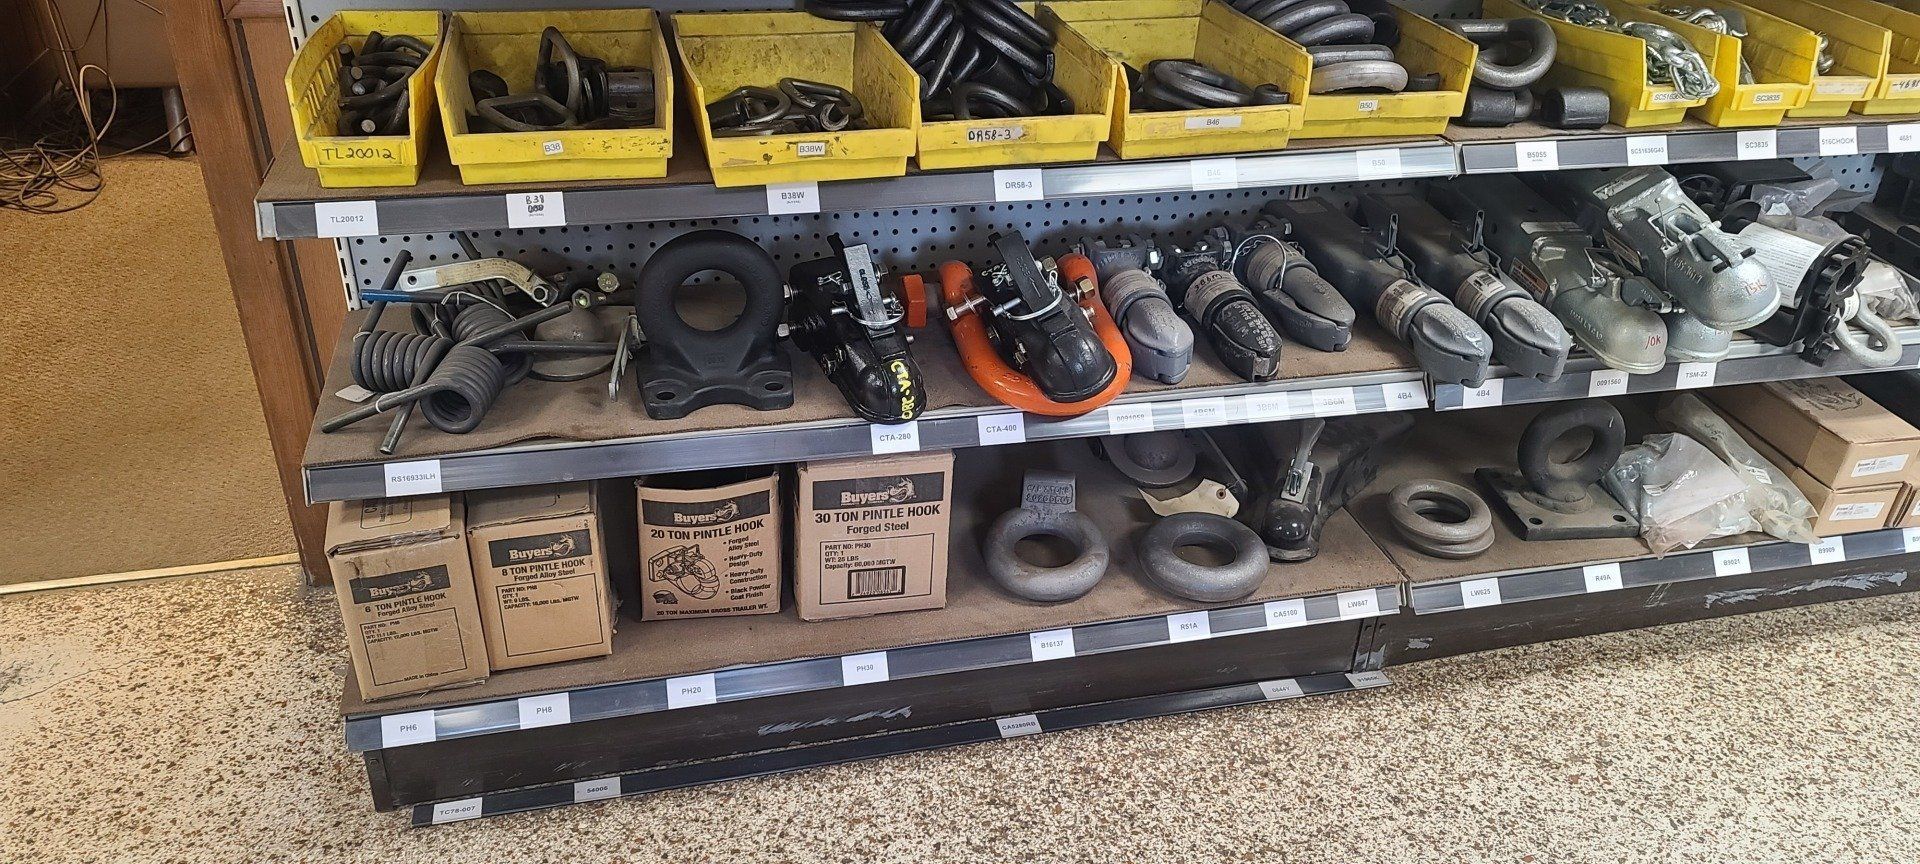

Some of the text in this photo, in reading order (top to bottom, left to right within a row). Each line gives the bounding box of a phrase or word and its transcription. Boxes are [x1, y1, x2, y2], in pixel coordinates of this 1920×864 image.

[1206, 118, 1220, 126] B46
[1745, 141, 1769, 149] SC3835
[1822, 138, 1855, 146] 516CHOOK
[544, 143, 561, 153] B38
[800, 144, 823, 154] B38W
[322, 147, 396, 162] TL20012
[1527, 151, 1547, 159] B5055
[1005, 181, 1033, 190] DR58-3
[782, 191, 805, 200] B38W
[330, 214, 364, 224] TL20012
[1685, 370, 1708, 379] TSM-22
[1596, 378, 1622, 387] 0091560
[890, 359, 916, 420] CTA-280
[1476, 389, 1490, 397] 4B4
[1397, 392, 1412, 400] 4B4
[986, 424, 1017, 434] CTA-400
[879, 433, 911, 442] CTA-280
[840, 491, 889, 505] Buyers
[673, 512, 717, 525] Buyers
[815, 504, 941, 524] 30 TON PINTLE HOOK
[651, 519, 764, 540] 20 TON PINTLE HOOK
[847, 521, 909, 535] Forged Steel
[728, 536, 749, 546] Forged
[728, 540, 760, 552] Alloy Steel
[508, 547, 553, 560] Buyers
[729, 551, 763, 562] Heavy-Duty
[502, 558, 586, 577] 8 TON PINTLE HOOK
[728, 560, 750, 568] Design
[514, 574, 538, 582] Forged
[539, 571, 556, 579] Alloy
[729, 568, 764, 578] Heavy-Duty
[729, 574, 768, 585] Construction
[730, 583, 771, 595] Black Powder
[730, 591, 764, 601] Coat Finish
[365, 592, 447, 613] 6 TON PINTLE HOOK
[377, 601, 436, 617] Forged Alloy Steel
[732, 604, 757, 612] TRAILER
[1273, 609, 1298, 618] CA5100
[1180, 623, 1198, 631] R51A
[1041, 640, 1064, 649] B16137
[856, 664, 874, 672] PH30
[681, 686, 702, 695] PH20
[536, 705, 553, 714] PH8
[400, 724, 418, 733] PH6
[439, 806, 476, 815] TC78-007
